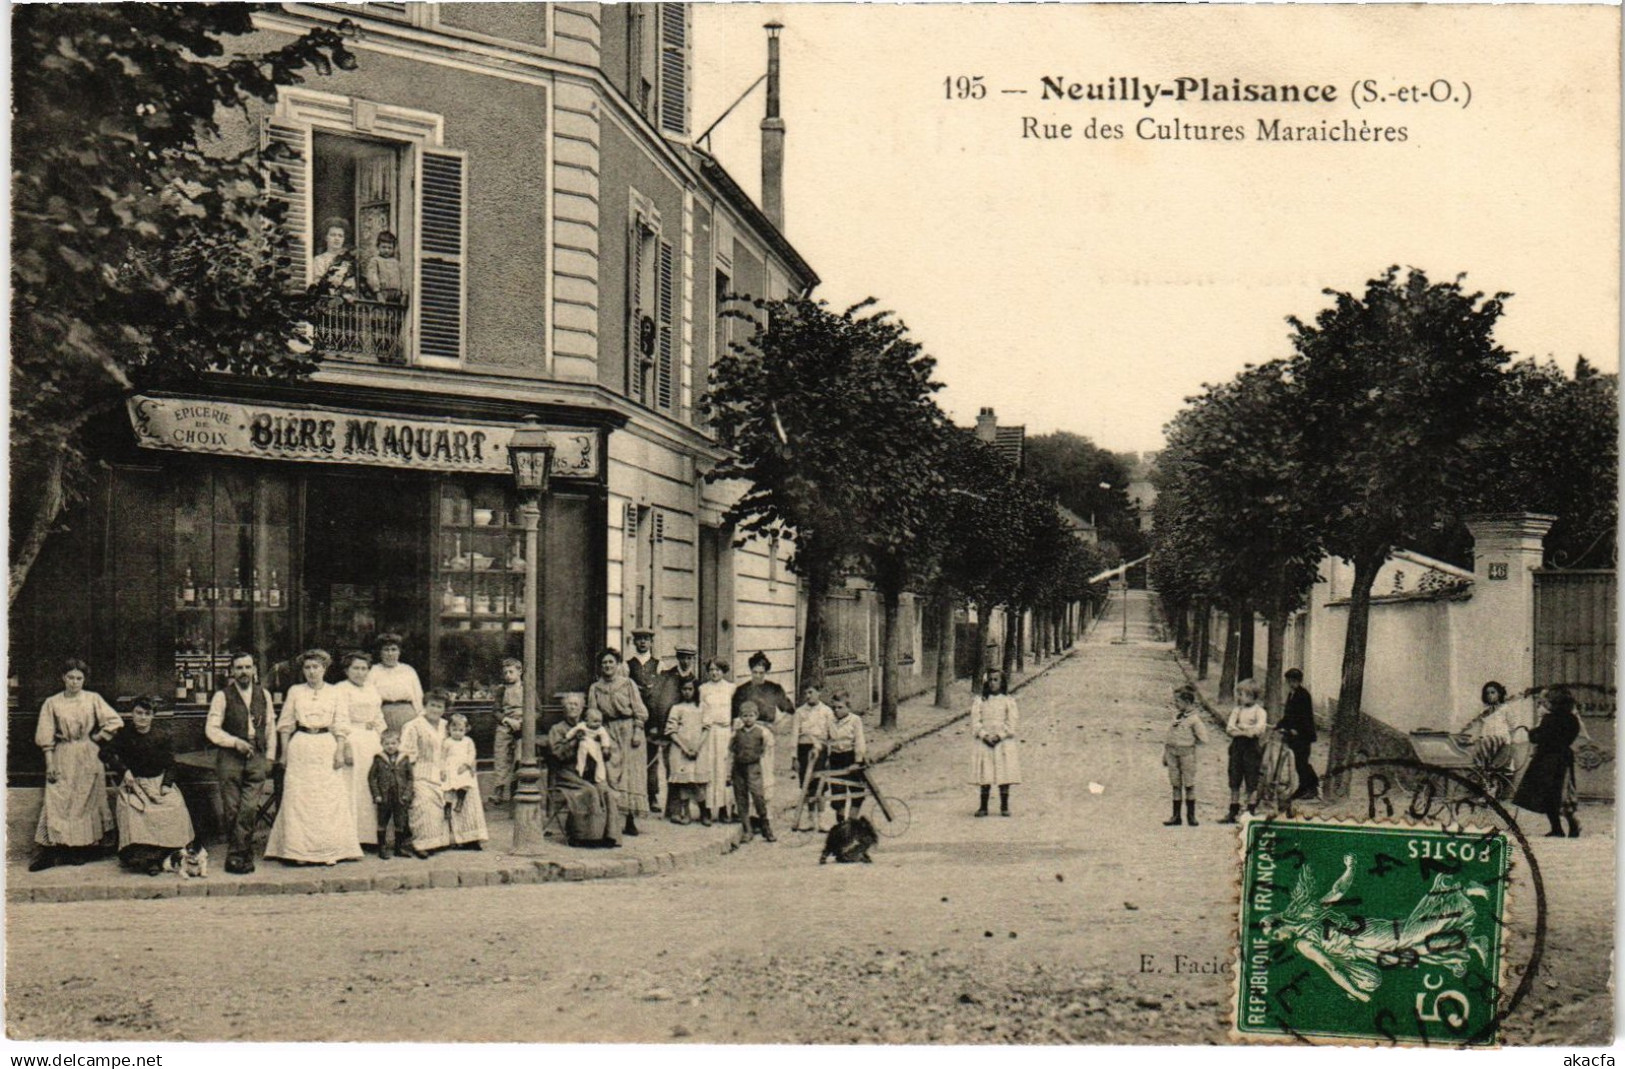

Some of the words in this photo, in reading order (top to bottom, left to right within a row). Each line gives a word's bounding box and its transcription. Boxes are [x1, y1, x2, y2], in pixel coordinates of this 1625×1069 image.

[195, 420, 210, 428] DE
[172, 429, 228, 446] CHOIX
[174, 406, 232, 425] EPICERIE
[344, 417, 487, 464] MAQUART
[1490, 564, 1507, 579] 46
[1407, 839, 1491, 863] POSTES
